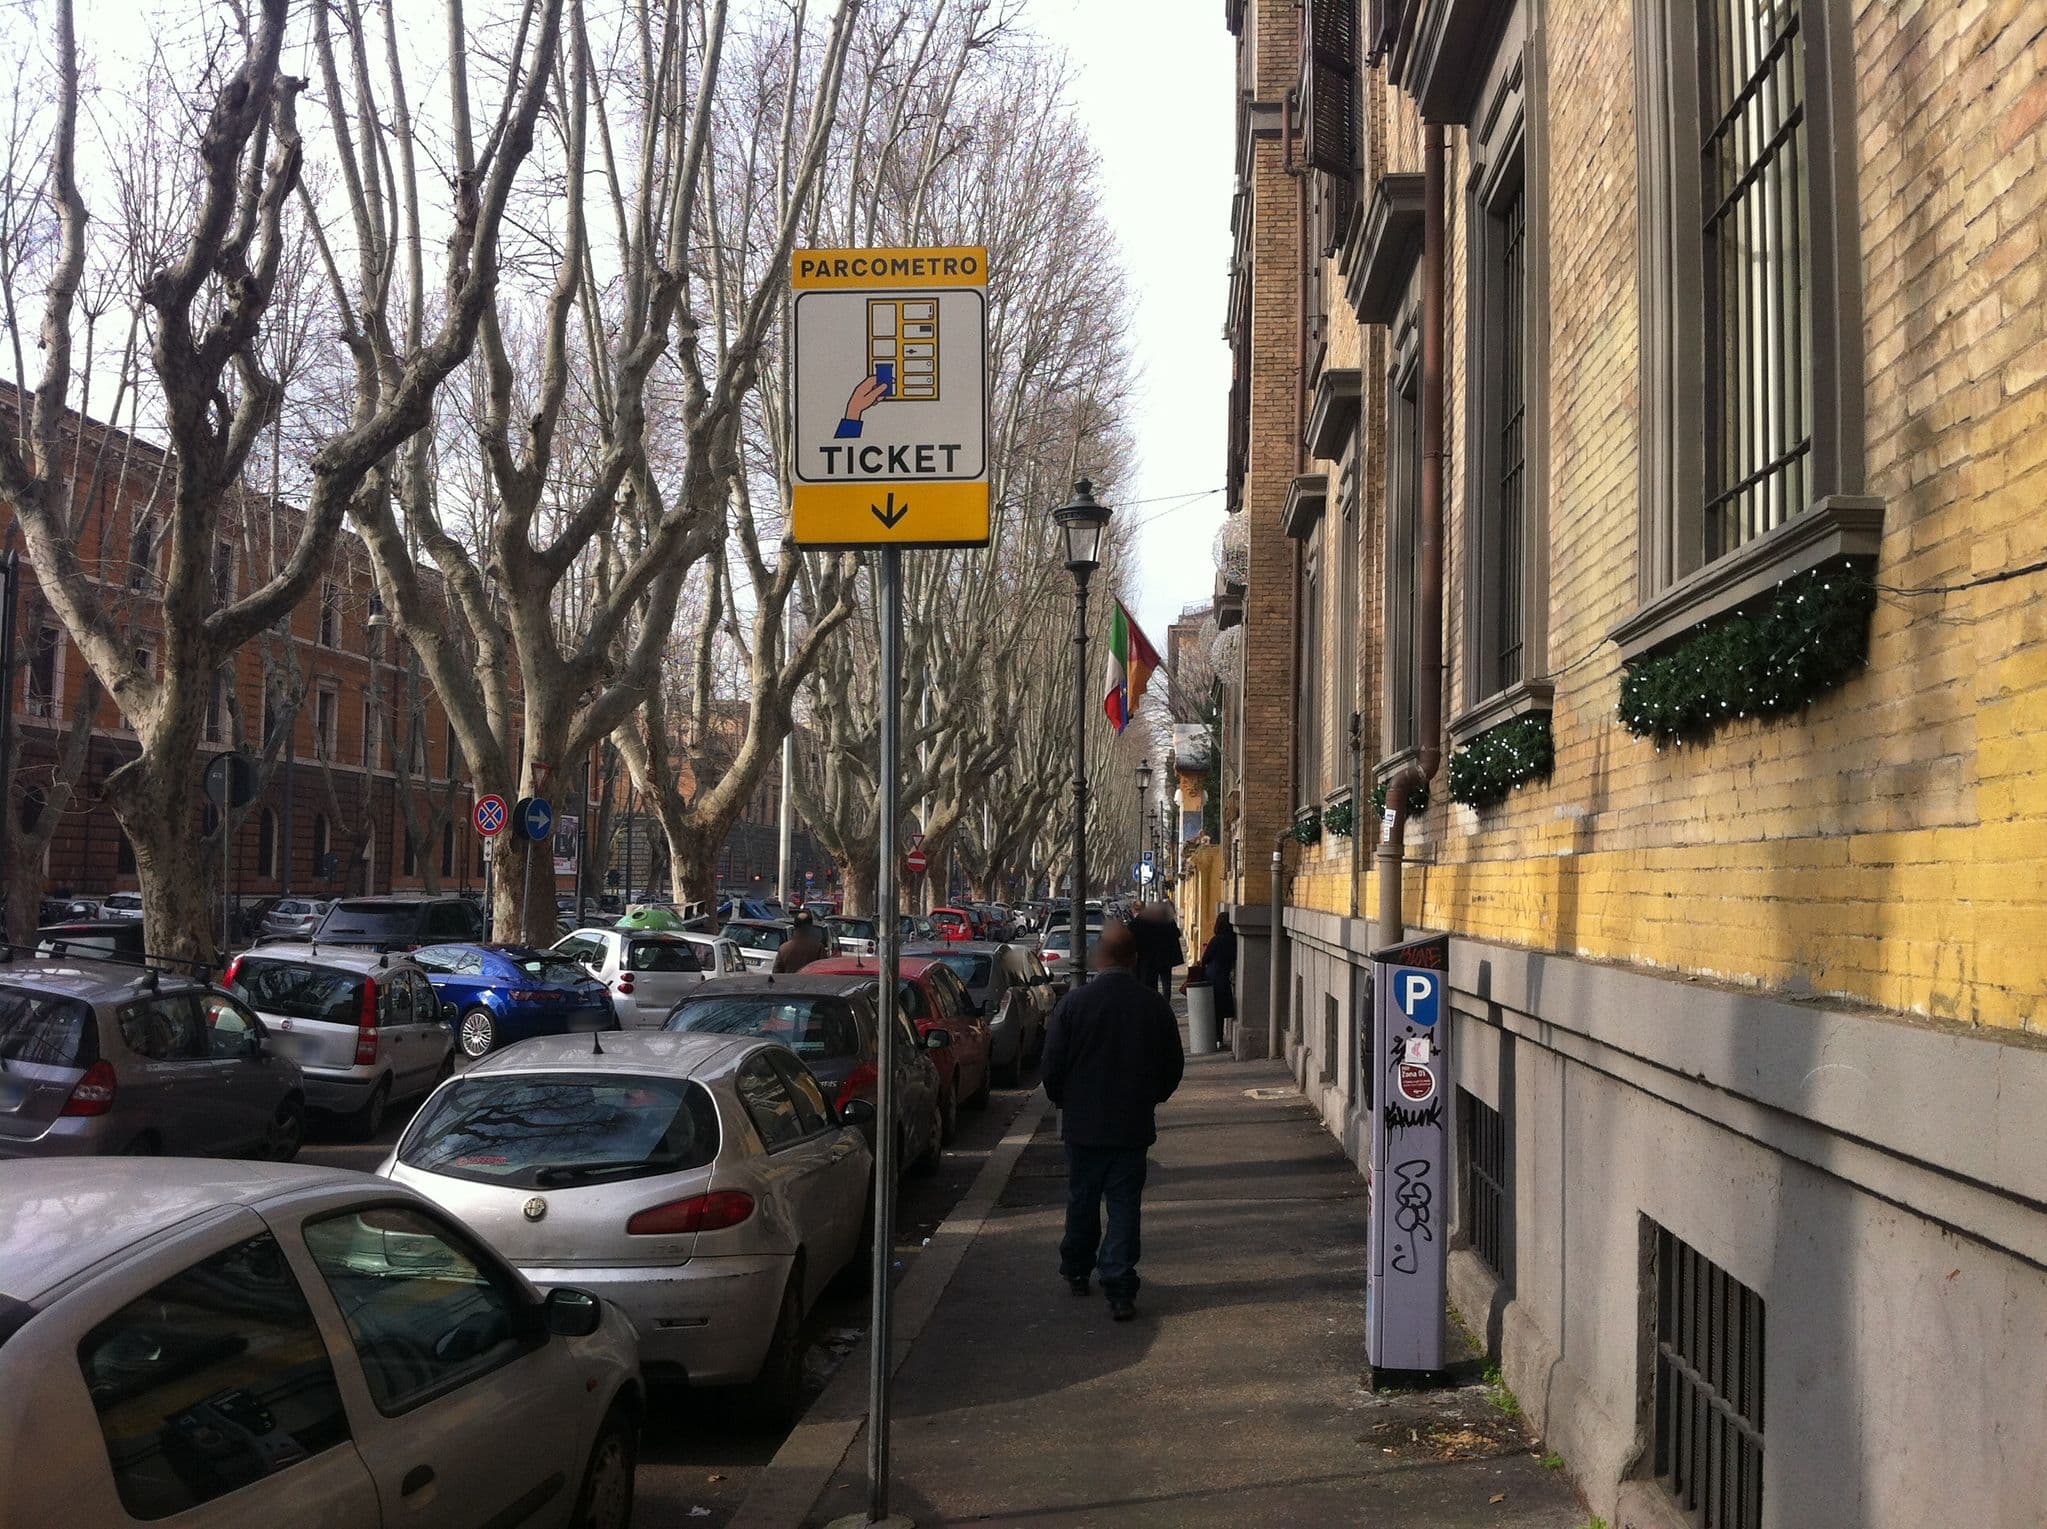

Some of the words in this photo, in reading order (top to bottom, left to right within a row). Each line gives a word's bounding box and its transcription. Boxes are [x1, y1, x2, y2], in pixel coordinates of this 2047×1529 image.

[801, 256, 978, 278] PARCOMETRO
[819, 444, 962, 474] TICKET
[1406, 975, 1432, 1015] P
